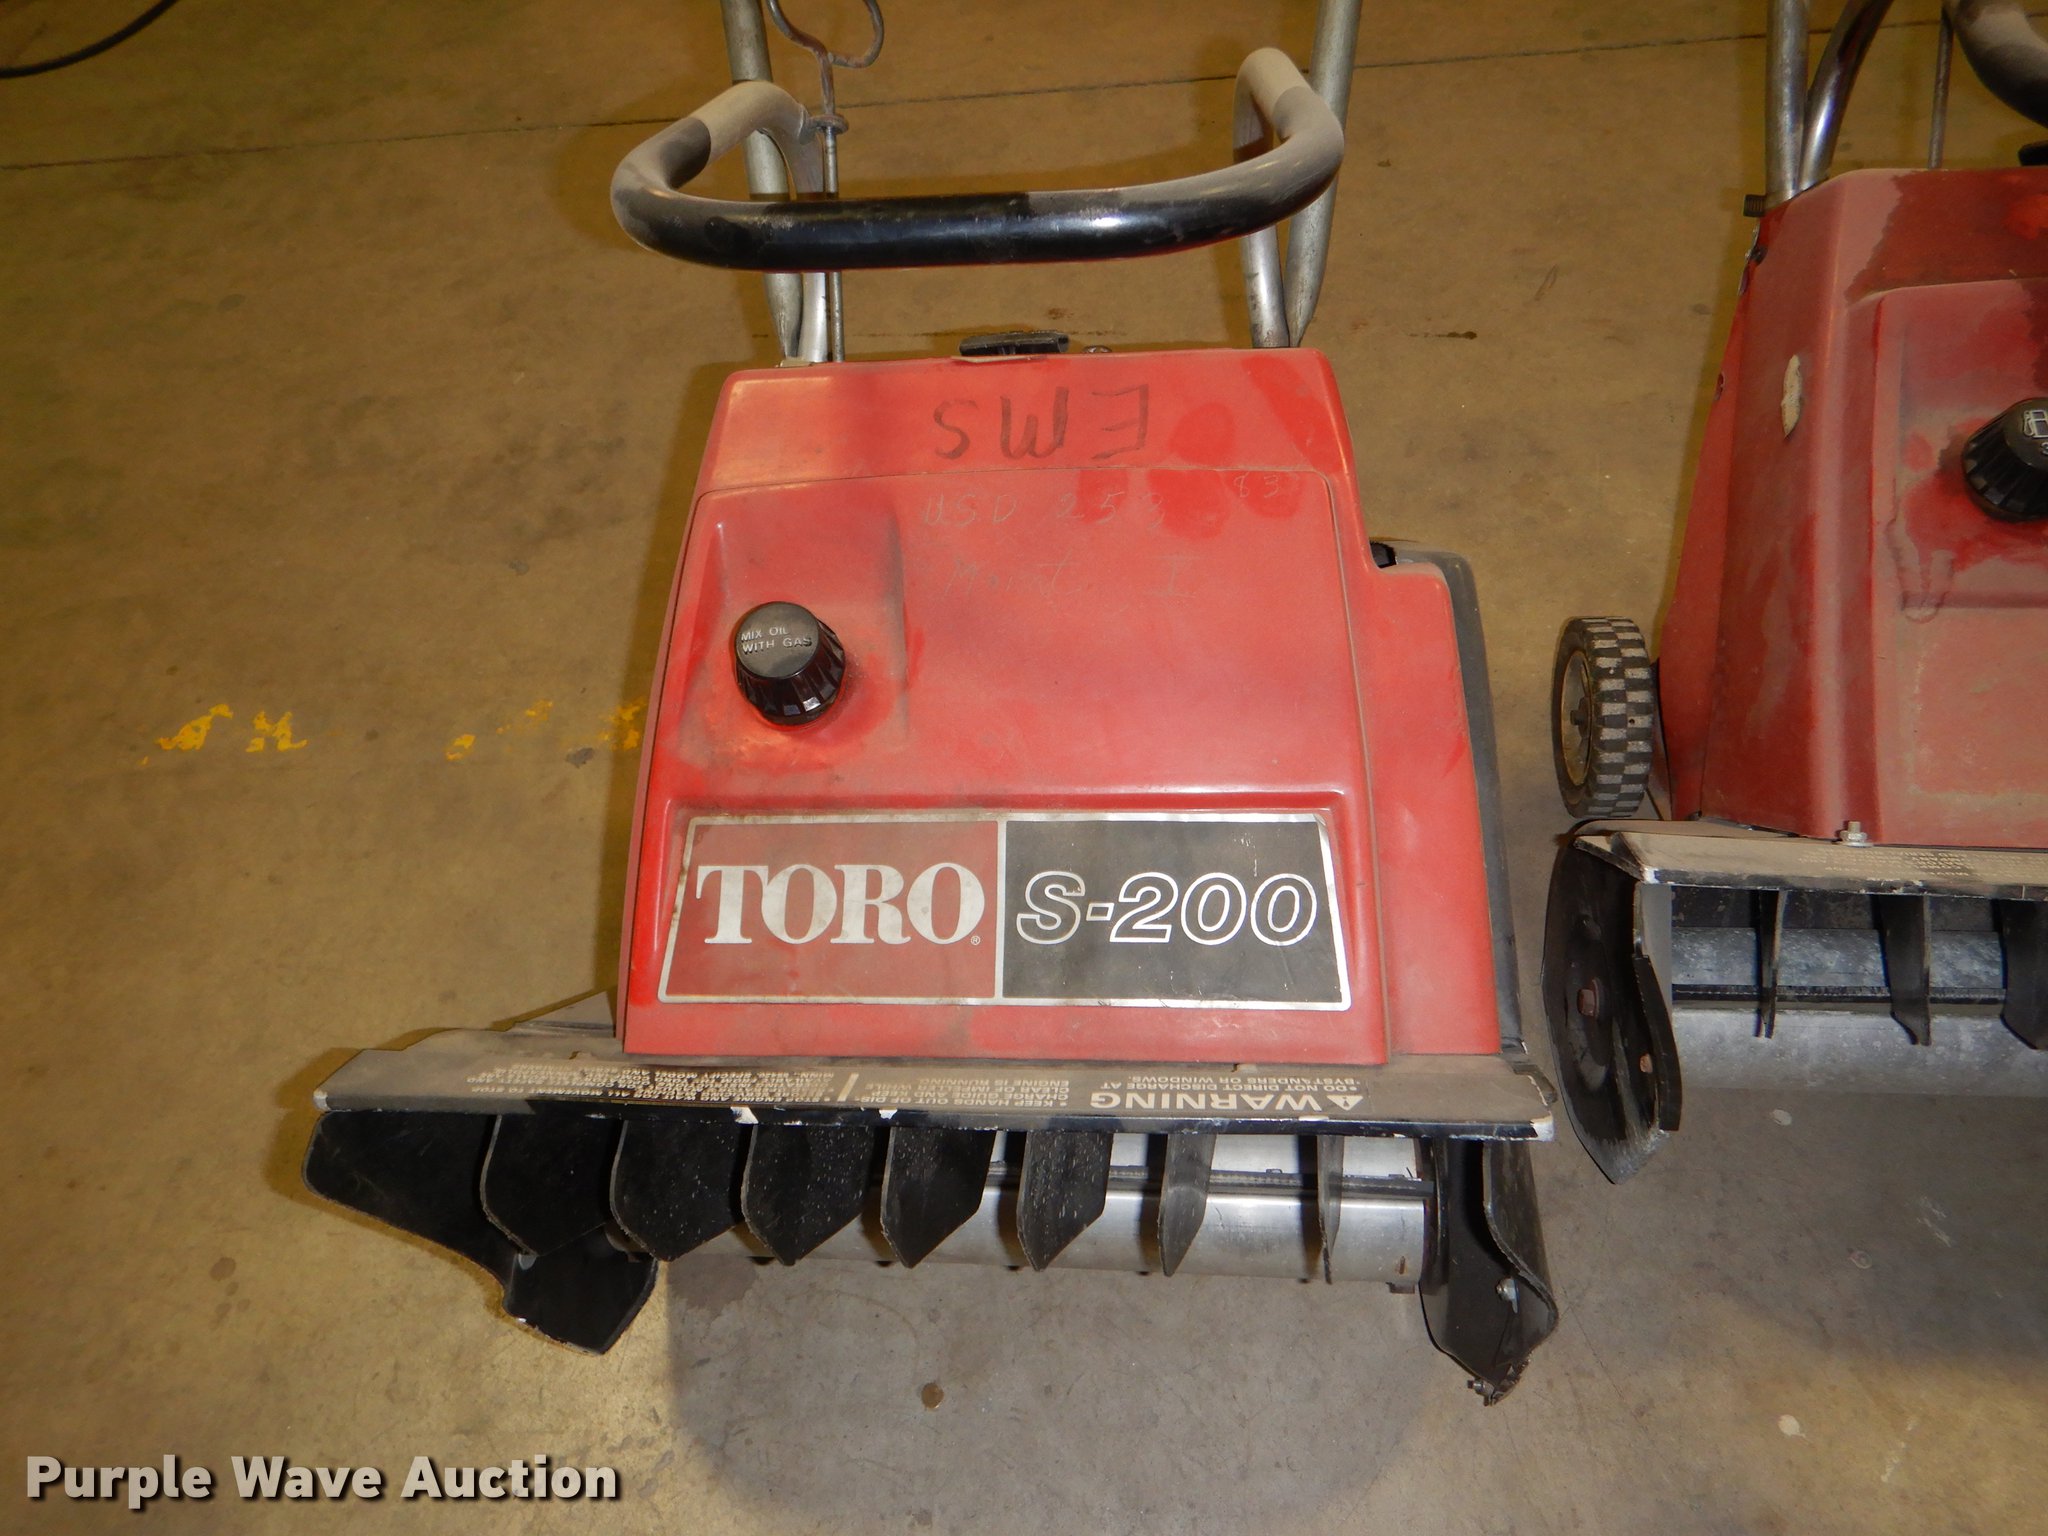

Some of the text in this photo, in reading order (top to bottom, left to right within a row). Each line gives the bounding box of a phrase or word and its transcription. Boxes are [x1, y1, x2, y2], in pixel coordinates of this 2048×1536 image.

[924, 493, 1017, 527] USD
[741, 627, 788, 641] MIX OIL
[742, 637, 812, 653] WITH GAS
[695, 861, 985, 945] TORO
[1016, 871, 1318, 946] S-200
[1013, 1079, 1069, 1087] ENGINE
[1100, 1082, 1122, 1090] AT
[1247, 1077, 1355, 1085] BYSTANDERS
[918, 1084, 990, 1093] IMPELLER
[1127, 1083, 1217, 1091] DISCHARGE
[954, 1098, 1009, 1106] HANDS
[1090, 1092, 1322, 1112] WARNING
